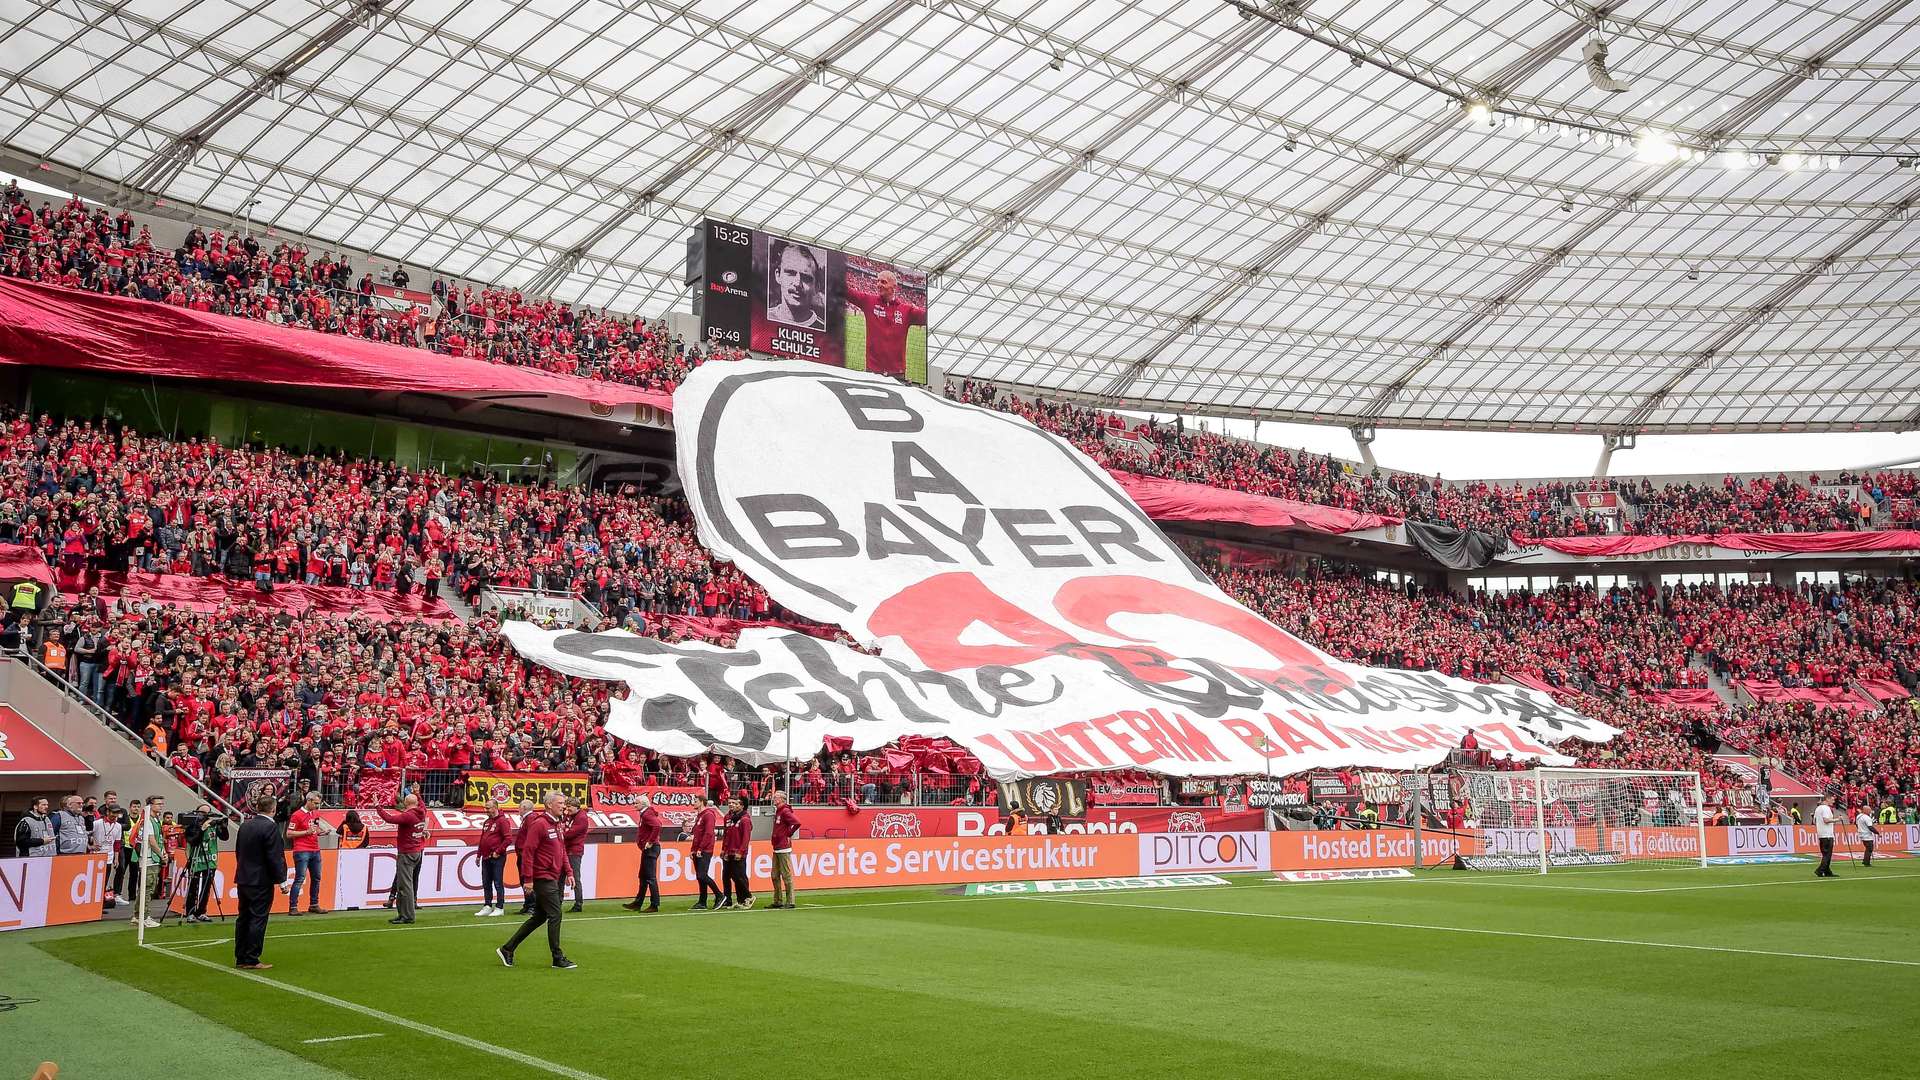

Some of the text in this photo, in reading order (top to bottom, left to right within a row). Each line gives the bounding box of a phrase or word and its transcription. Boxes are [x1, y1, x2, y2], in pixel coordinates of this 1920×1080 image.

[713, 226, 748, 246] 15:25
[710, 283, 748, 297] BayArena
[708, 326, 740, 341] 05:49
[778, 327, 814, 344] KLAUS
[771, 339, 821, 358] SCHULZE
[736, 493, 1166, 569] BAYER
[553, 633, 1064, 751] Jahre
[975, 707, 1233, 771] UNTERM
[1250, 780, 1282, 792] SEKTON
[1248, 793, 1305, 806] STADONVERBOT
[1153, 832, 1259, 866] DITCON
[1303, 833, 1461, 863] Hosted Exchange
[1496, 830, 1568, 855] DITCON
[1647, 832, 1697, 856] @ditcon
[1735, 827, 1788, 849] DITCON
[659, 838, 1098, 883] Buneweite Servicestruktur
[976, 875, 1218, 895] KB FENSTER
